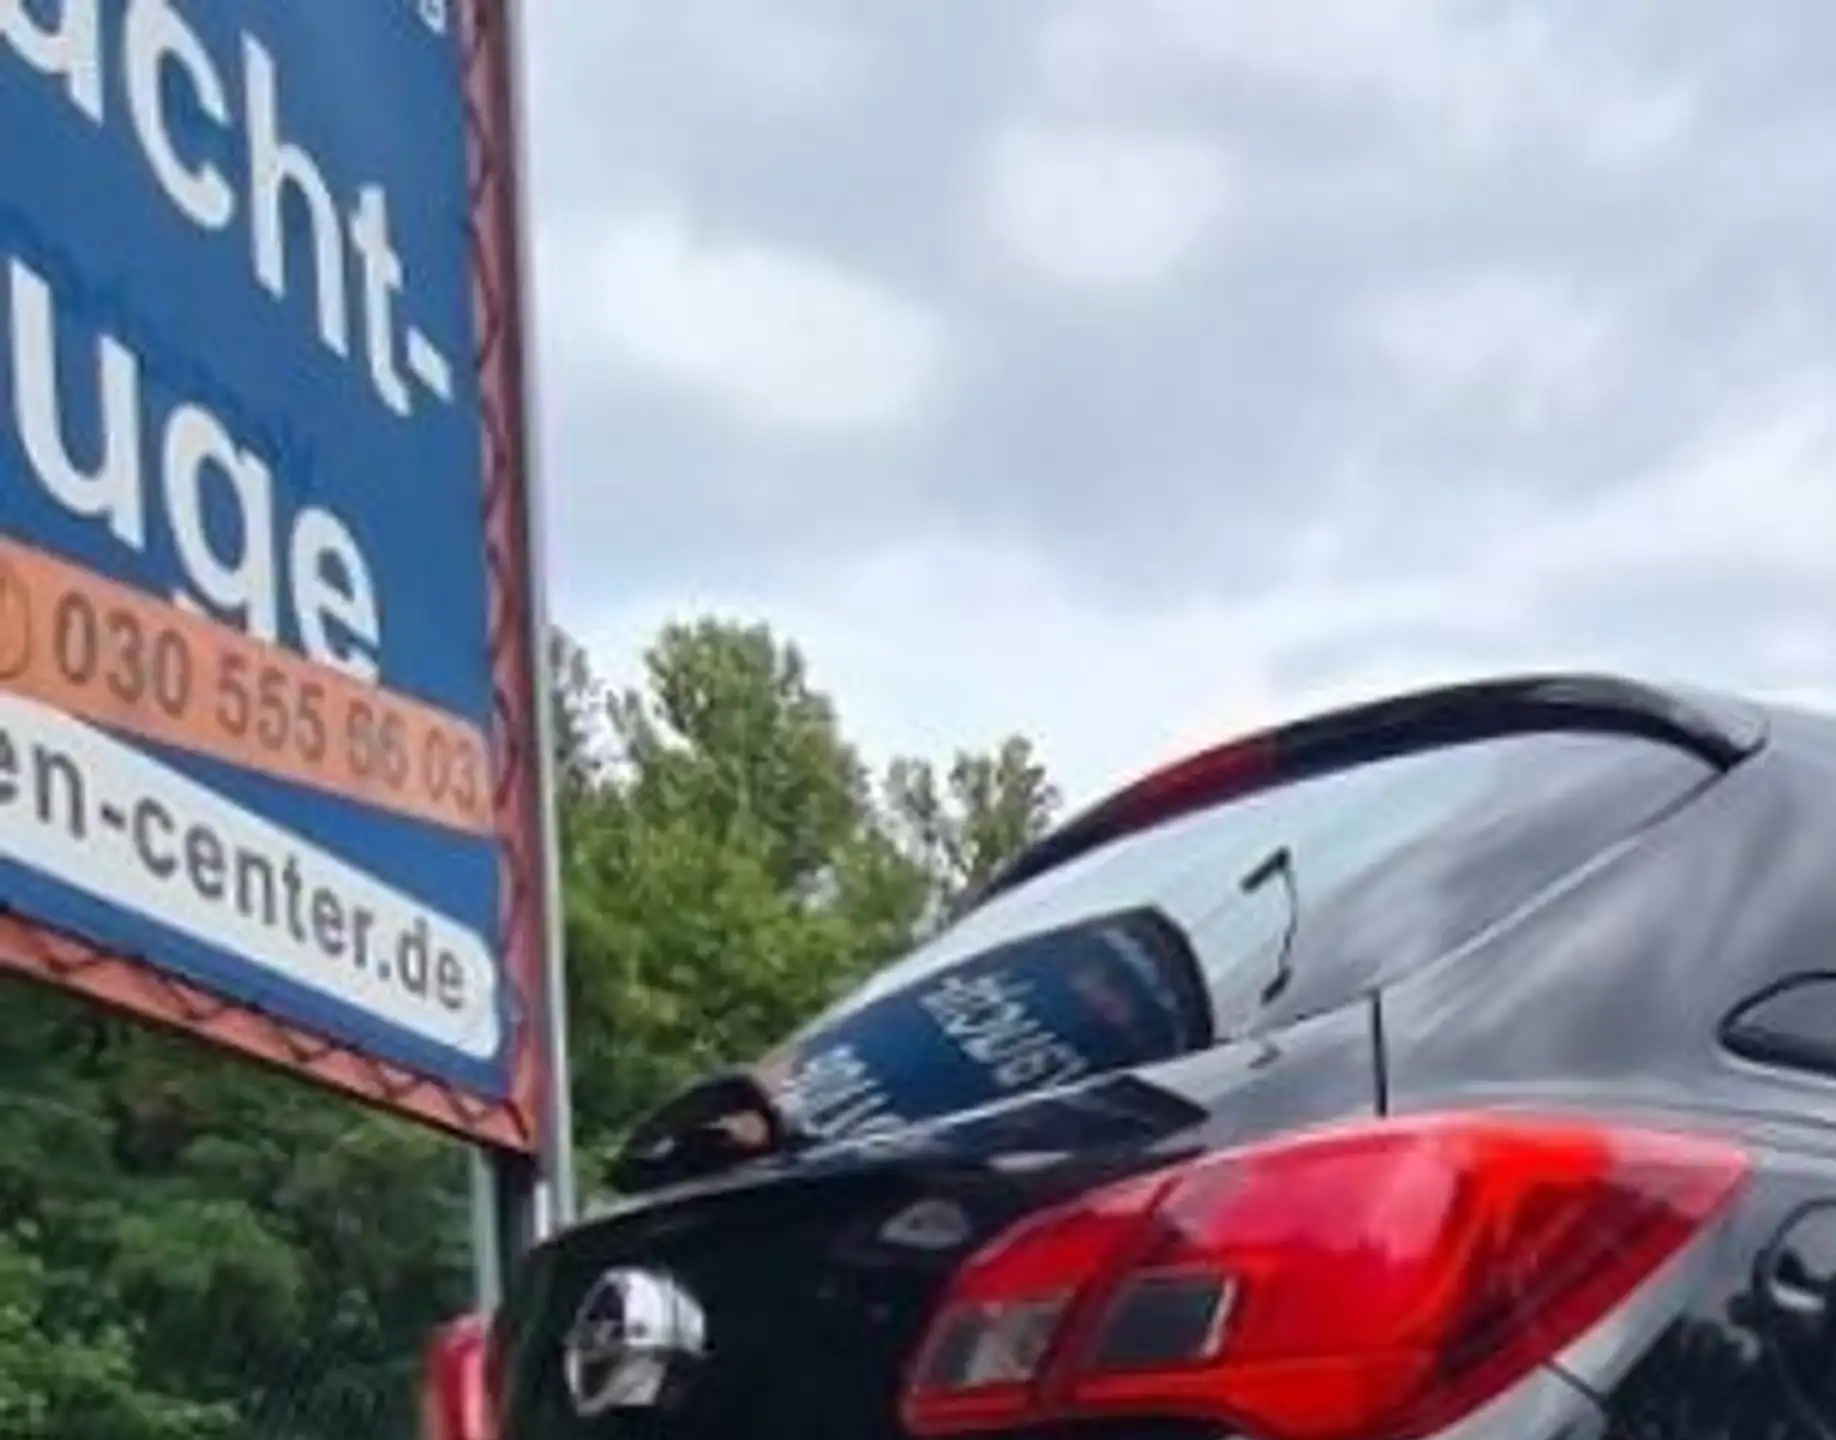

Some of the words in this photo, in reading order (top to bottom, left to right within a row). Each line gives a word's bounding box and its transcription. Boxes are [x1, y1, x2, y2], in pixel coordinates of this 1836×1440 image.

[55, 588, 190, 720] 030
[215, 650, 327, 764] 555
[420, 725, 477, 813] 03
